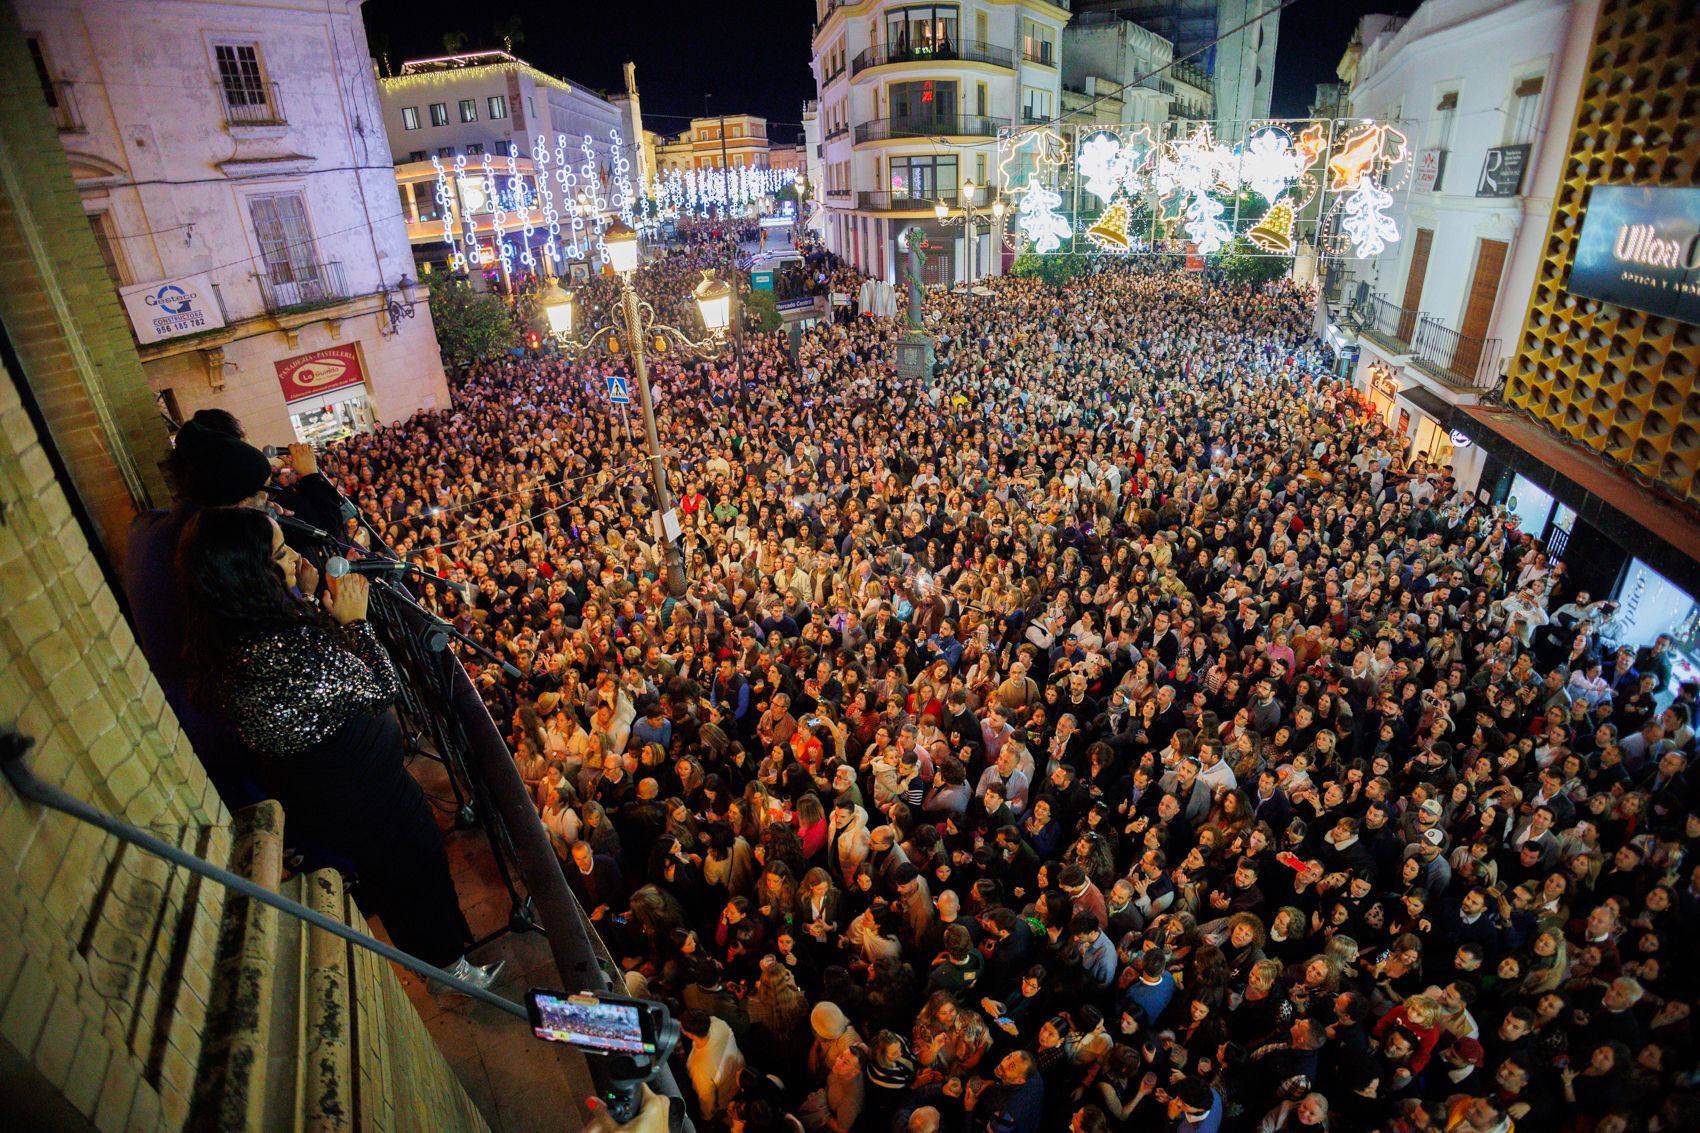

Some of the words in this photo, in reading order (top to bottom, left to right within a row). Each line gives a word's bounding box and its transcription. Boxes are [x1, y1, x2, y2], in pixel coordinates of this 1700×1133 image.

[1478, 150, 1502, 192] R
[153, 312, 203, 326] CONSTRUCTORA
[156, 326, 172, 335] 956
[174, 323, 188, 331] 185
[191, 319, 205, 327] 782
